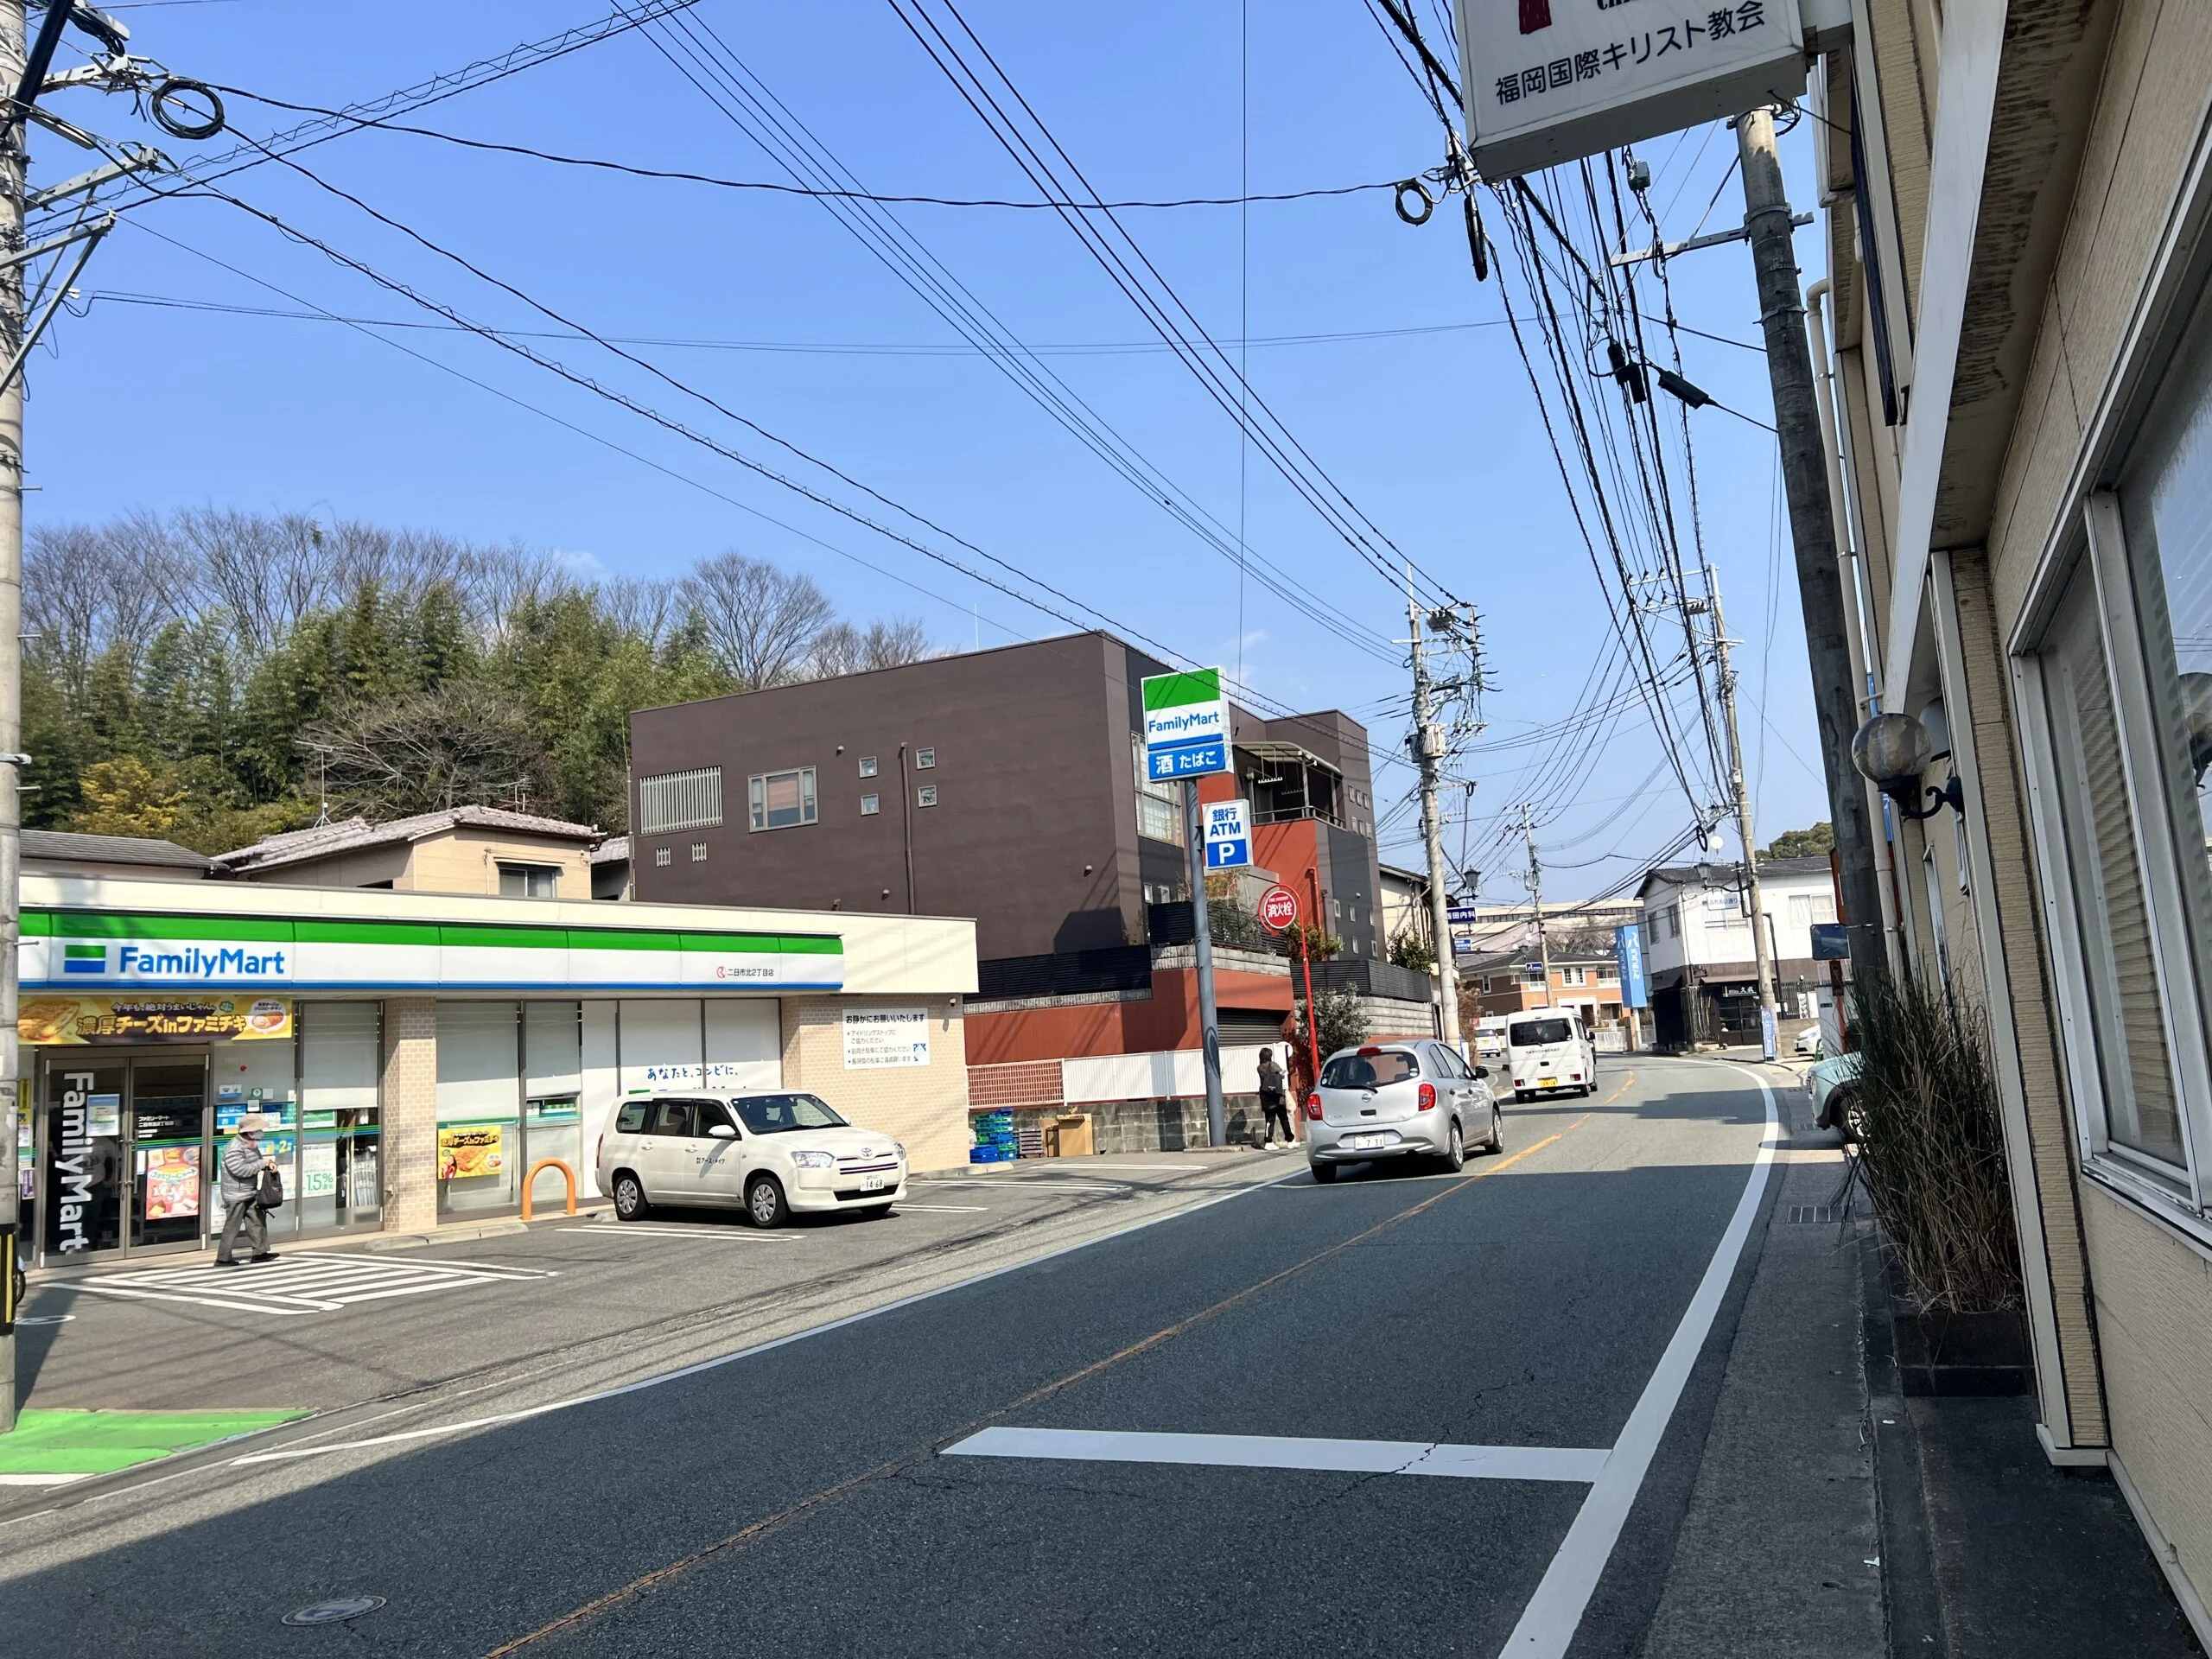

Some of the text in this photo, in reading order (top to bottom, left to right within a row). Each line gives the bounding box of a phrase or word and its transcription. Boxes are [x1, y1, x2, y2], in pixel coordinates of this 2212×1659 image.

[1496, 1, 1764, 105] 福岡国際キリスト教会
[1148, 711, 1220, 733] FamilyMart
[1156, 751, 1217, 774] 酒 たばこ
[1212, 808, 1237, 822] 銀行
[1210, 822, 1242, 837] ATM
[1218, 843, 1236, 864] P
[1267, 901, 1294, 918] 消火栓
[119, 946, 285, 978] FamilyMart
[727, 969, 775, 977] 二日市北2丁目店
[111, 1001, 216, 1012] 今年も、絶対うまいじゃん。
[76, 1014, 247, 1036] 濃厚チーズinファミチキ
[846, 1014, 925, 1025] お静かにお願いいたします
[647, 1064, 739, 1081] あなたと、コンビに、
[278, 1140, 289, 1154] 2
[54, 1071, 95, 1253] FamilyMart
